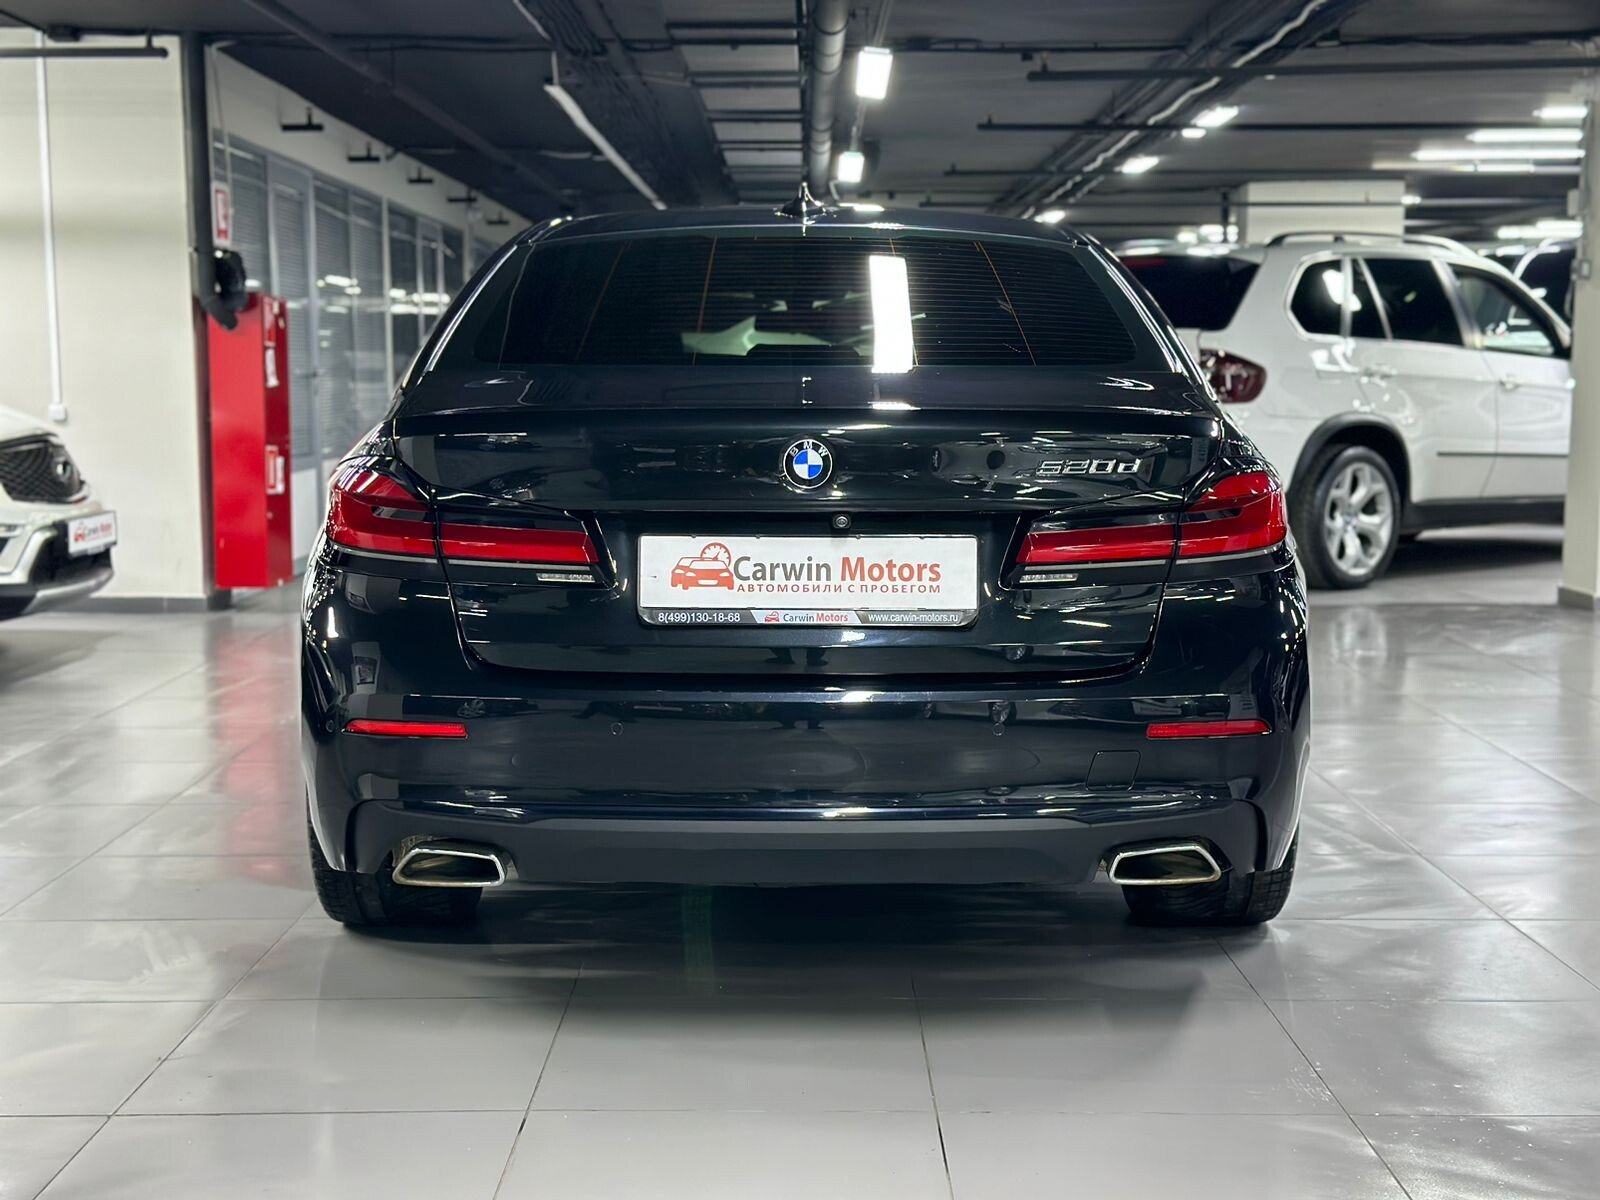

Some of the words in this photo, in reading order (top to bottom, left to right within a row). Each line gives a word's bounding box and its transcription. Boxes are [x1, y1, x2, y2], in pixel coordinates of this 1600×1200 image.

[789, 440, 828, 457] BMW
[1036, 458, 1142, 475] 520d
[733, 556, 832, 582] Carwin
[840, 556, 942, 582] Motors
[737, 583, 842, 593] АВТОМОБИЛИ
[847, 584, 856, 593] С
[860, 584, 941, 593] ПРОБЕГОМ
[658, 612, 741, 624] 8(499)130-18-68
[783, 612, 815, 622] Carwin
[816, 612, 849, 623] Motors
[868, 613, 959, 623] www.carwin-motors.ru
